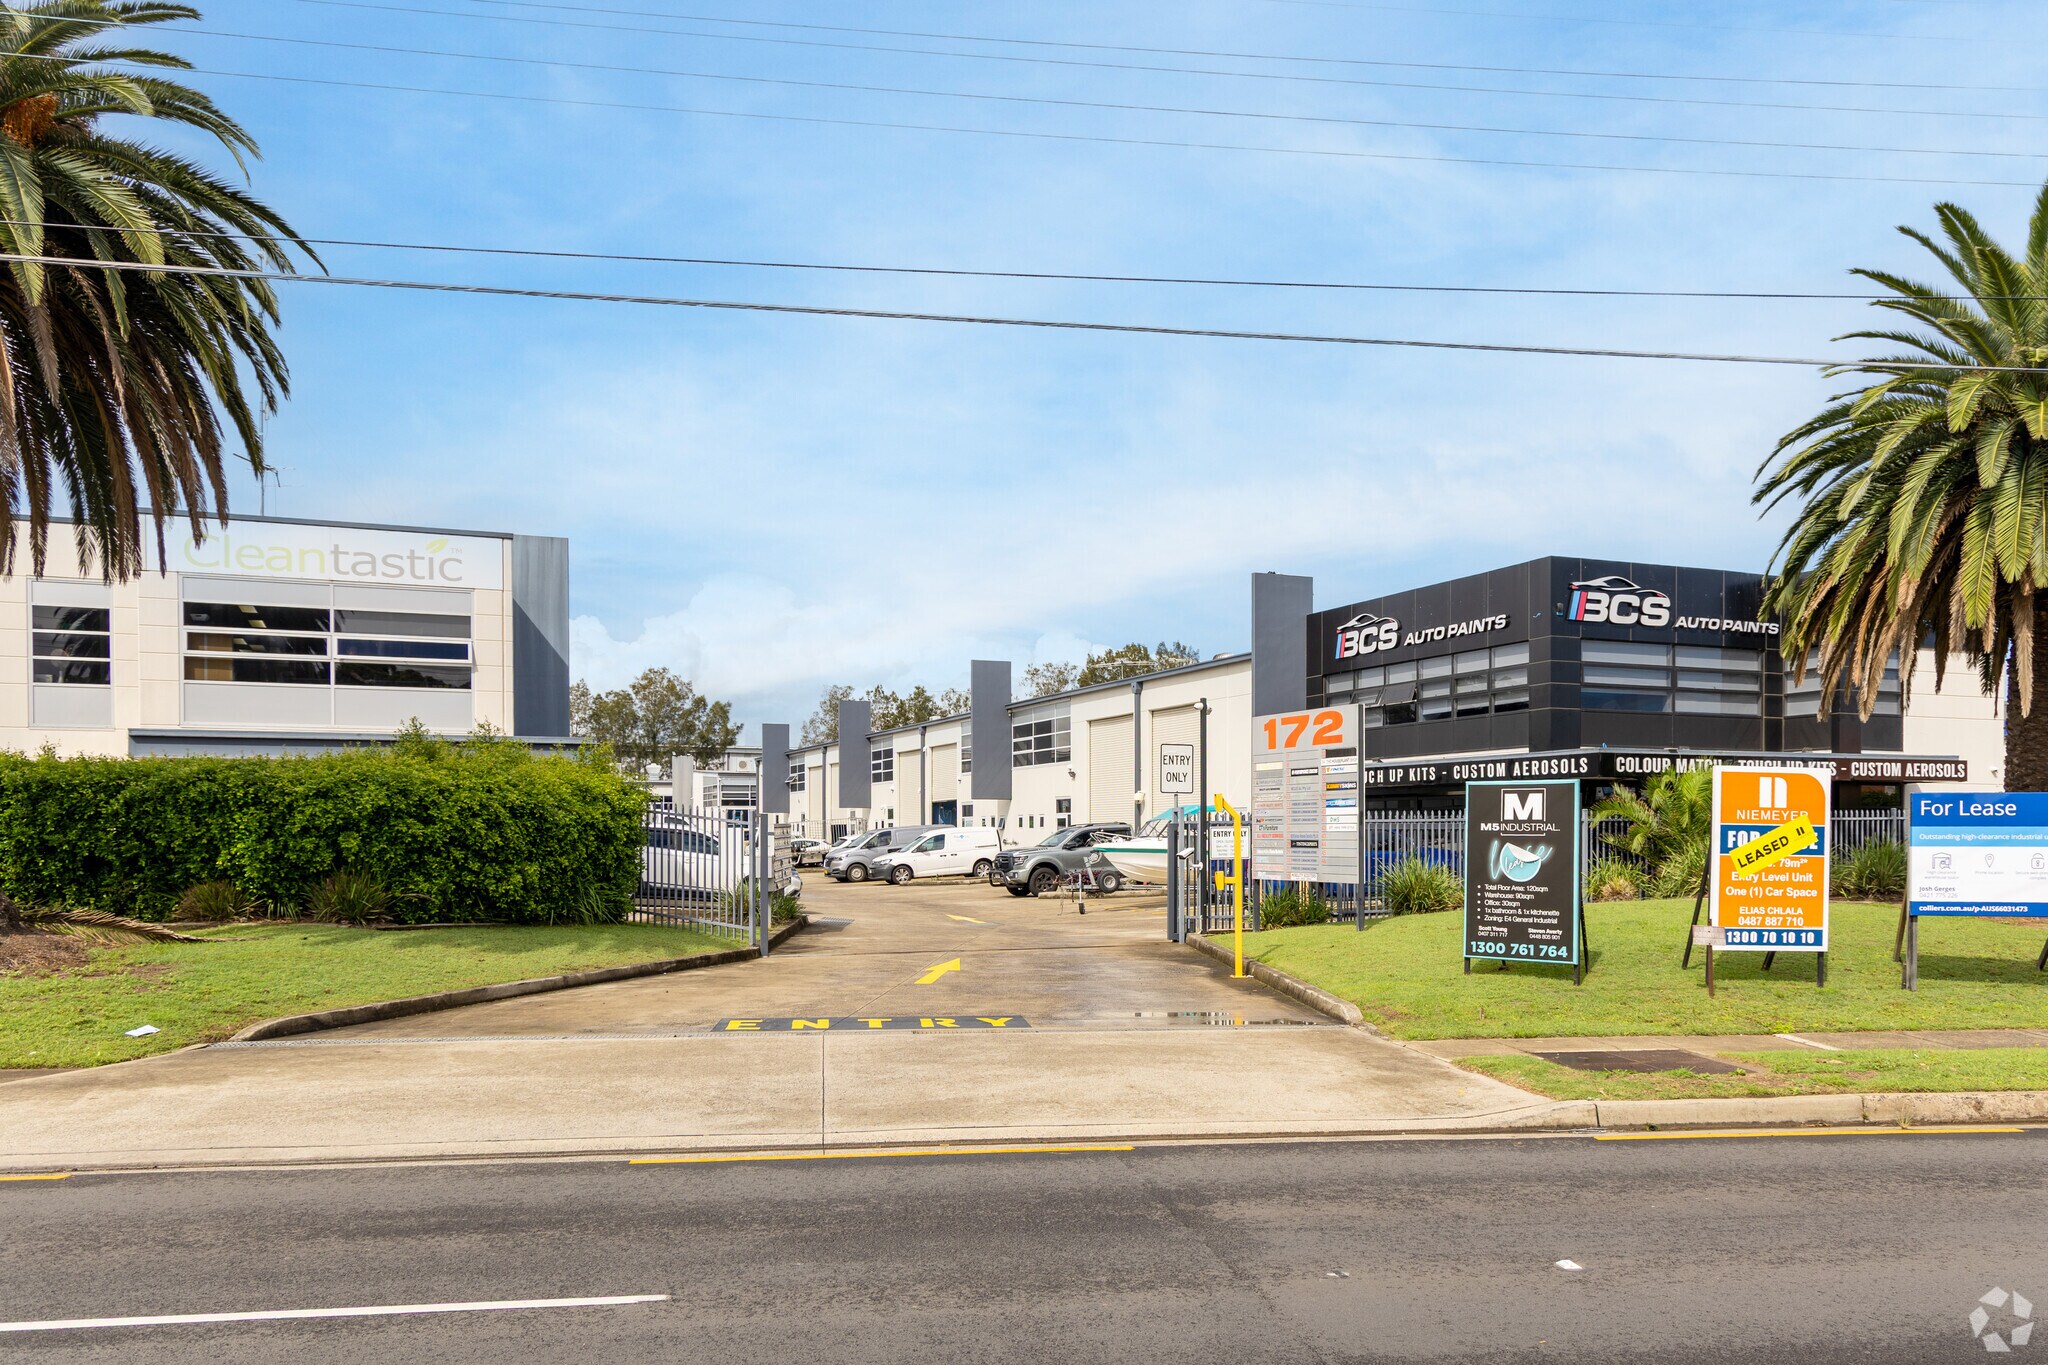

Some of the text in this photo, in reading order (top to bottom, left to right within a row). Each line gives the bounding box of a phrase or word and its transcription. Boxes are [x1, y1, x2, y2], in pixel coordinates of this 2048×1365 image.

[184, 534, 463, 582] Cleantastic
[1568, 590, 1780, 635] BCS AUTO PAINTS
[1335, 614, 1507, 660] BCS AUTO PAINTS
[1264, 710, 1344, 750] 172
[1163, 755, 1190, 766] ENTRY
[1616, 756, 1672, 773] COLOUR
[1389, 768, 1404, 783] UP
[1409, 766, 1436, 782] KITS
[1453, 762, 1506, 780] CUSTOM
[1513, 757, 1588, 777] AEROSOLS
[1851, 761, 1902, 777] CUSTOM
[1906, 762, 1966, 778] AEROSOLS
[1166, 772, 1188, 783] ONLY
[1503, 792, 1543, 820] M
[1920, 800, 2017, 816] For Lease
[1213, 830, 1232, 838] ENTRY
[1919, 833, 1960, 842] Outstanding
[1961, 833, 2010, 842] high-clearance
[1737, 835, 1789, 868] LEASED
[1761, 872, 1789, 882] Level
[1792, 872, 1813, 882] Unit
[1484, 883, 1497, 891] Total
[1526, 885, 1549, 893] 120sqm
[1484, 891, 1515, 899] Warehouse:
[1725, 885, 1818, 899] One (1) Car Space
[1501, 900, 1521, 908] 30sqm
[1739, 906, 1803, 915] ELIAS CHLALA
[1484, 914, 1503, 923] Zoning:
[1738, 916, 1804, 927] 0487 887 710
[1726, 931, 1815, 944] 1300 70 10 10
[1471, 941, 1568, 958] 1300 761 764
[724, 1017, 1013, 1031] ENTRY
